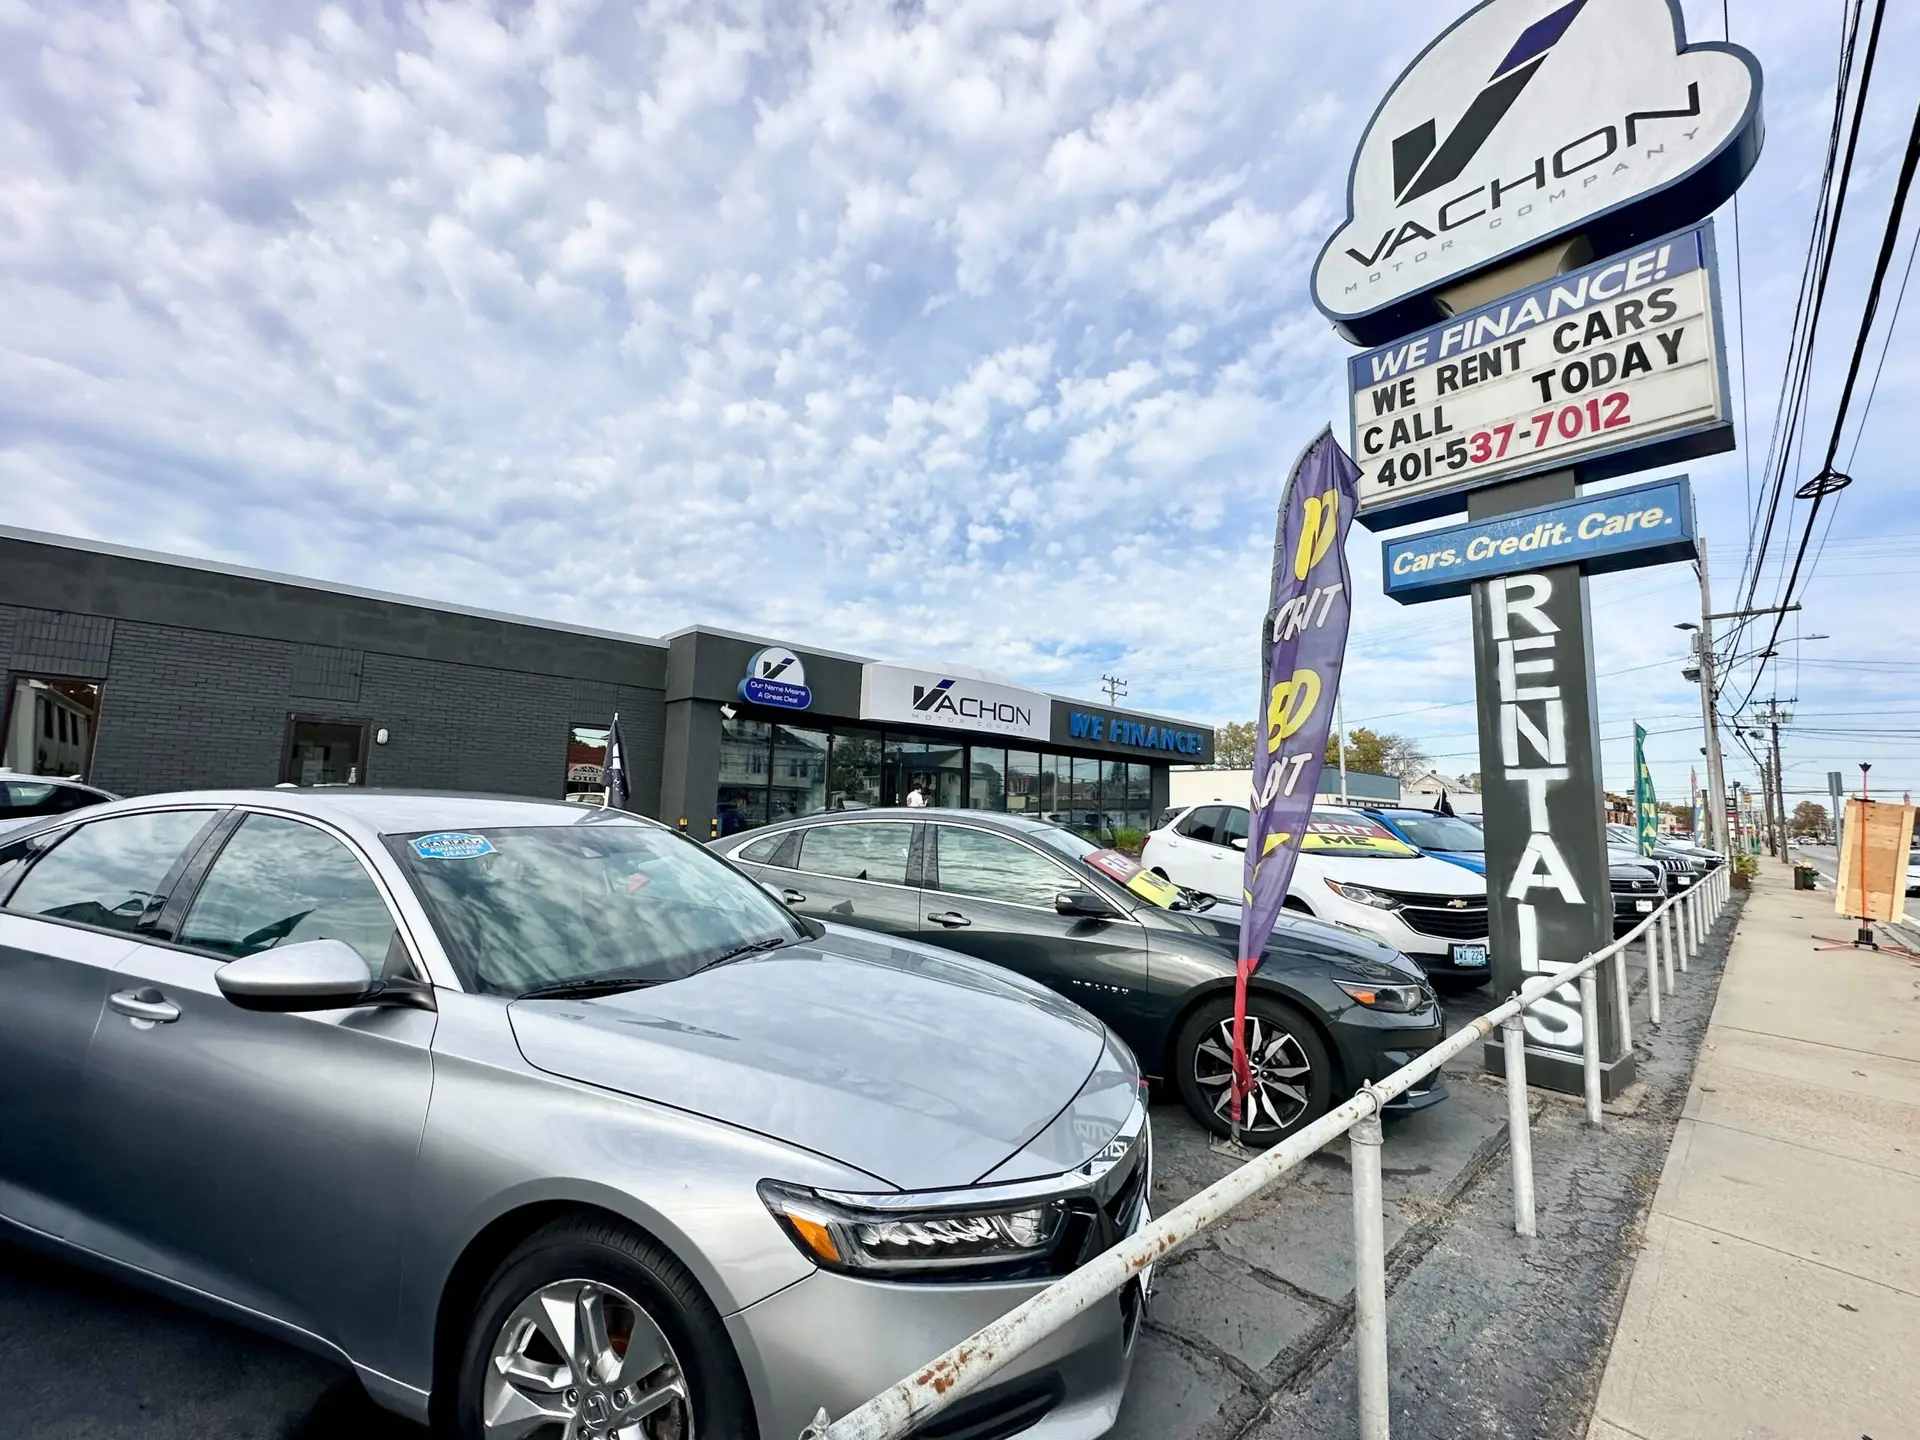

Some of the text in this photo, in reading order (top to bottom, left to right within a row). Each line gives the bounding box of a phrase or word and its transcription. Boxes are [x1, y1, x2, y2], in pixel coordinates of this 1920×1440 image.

[1344, 127, 1700, 294] MOTOR COMPANY
[1345, 81, 1700, 267] VACHON
[1371, 244, 1673, 382] WE FINANCE!
[1372, 287, 1677, 416] WE RENT CARS
[1363, 327, 1686, 455] CALL TODAY
[1377, 392, 1631, 487] 401-537-7012
[1392, 507, 1673, 576] Cars. Credit. Care.
[750, 681, 806, 696] Our Name Means
[764, 692, 783, 702] Great
[911, 713, 1031, 732] MOTOR COMPANY
[913, 679, 1031, 726] VACHON
[1069, 712, 1204, 755] WE FINANCE!
[1318, 835, 1376, 847] ME
[1489, 573, 1586, 1047] RENTALS
